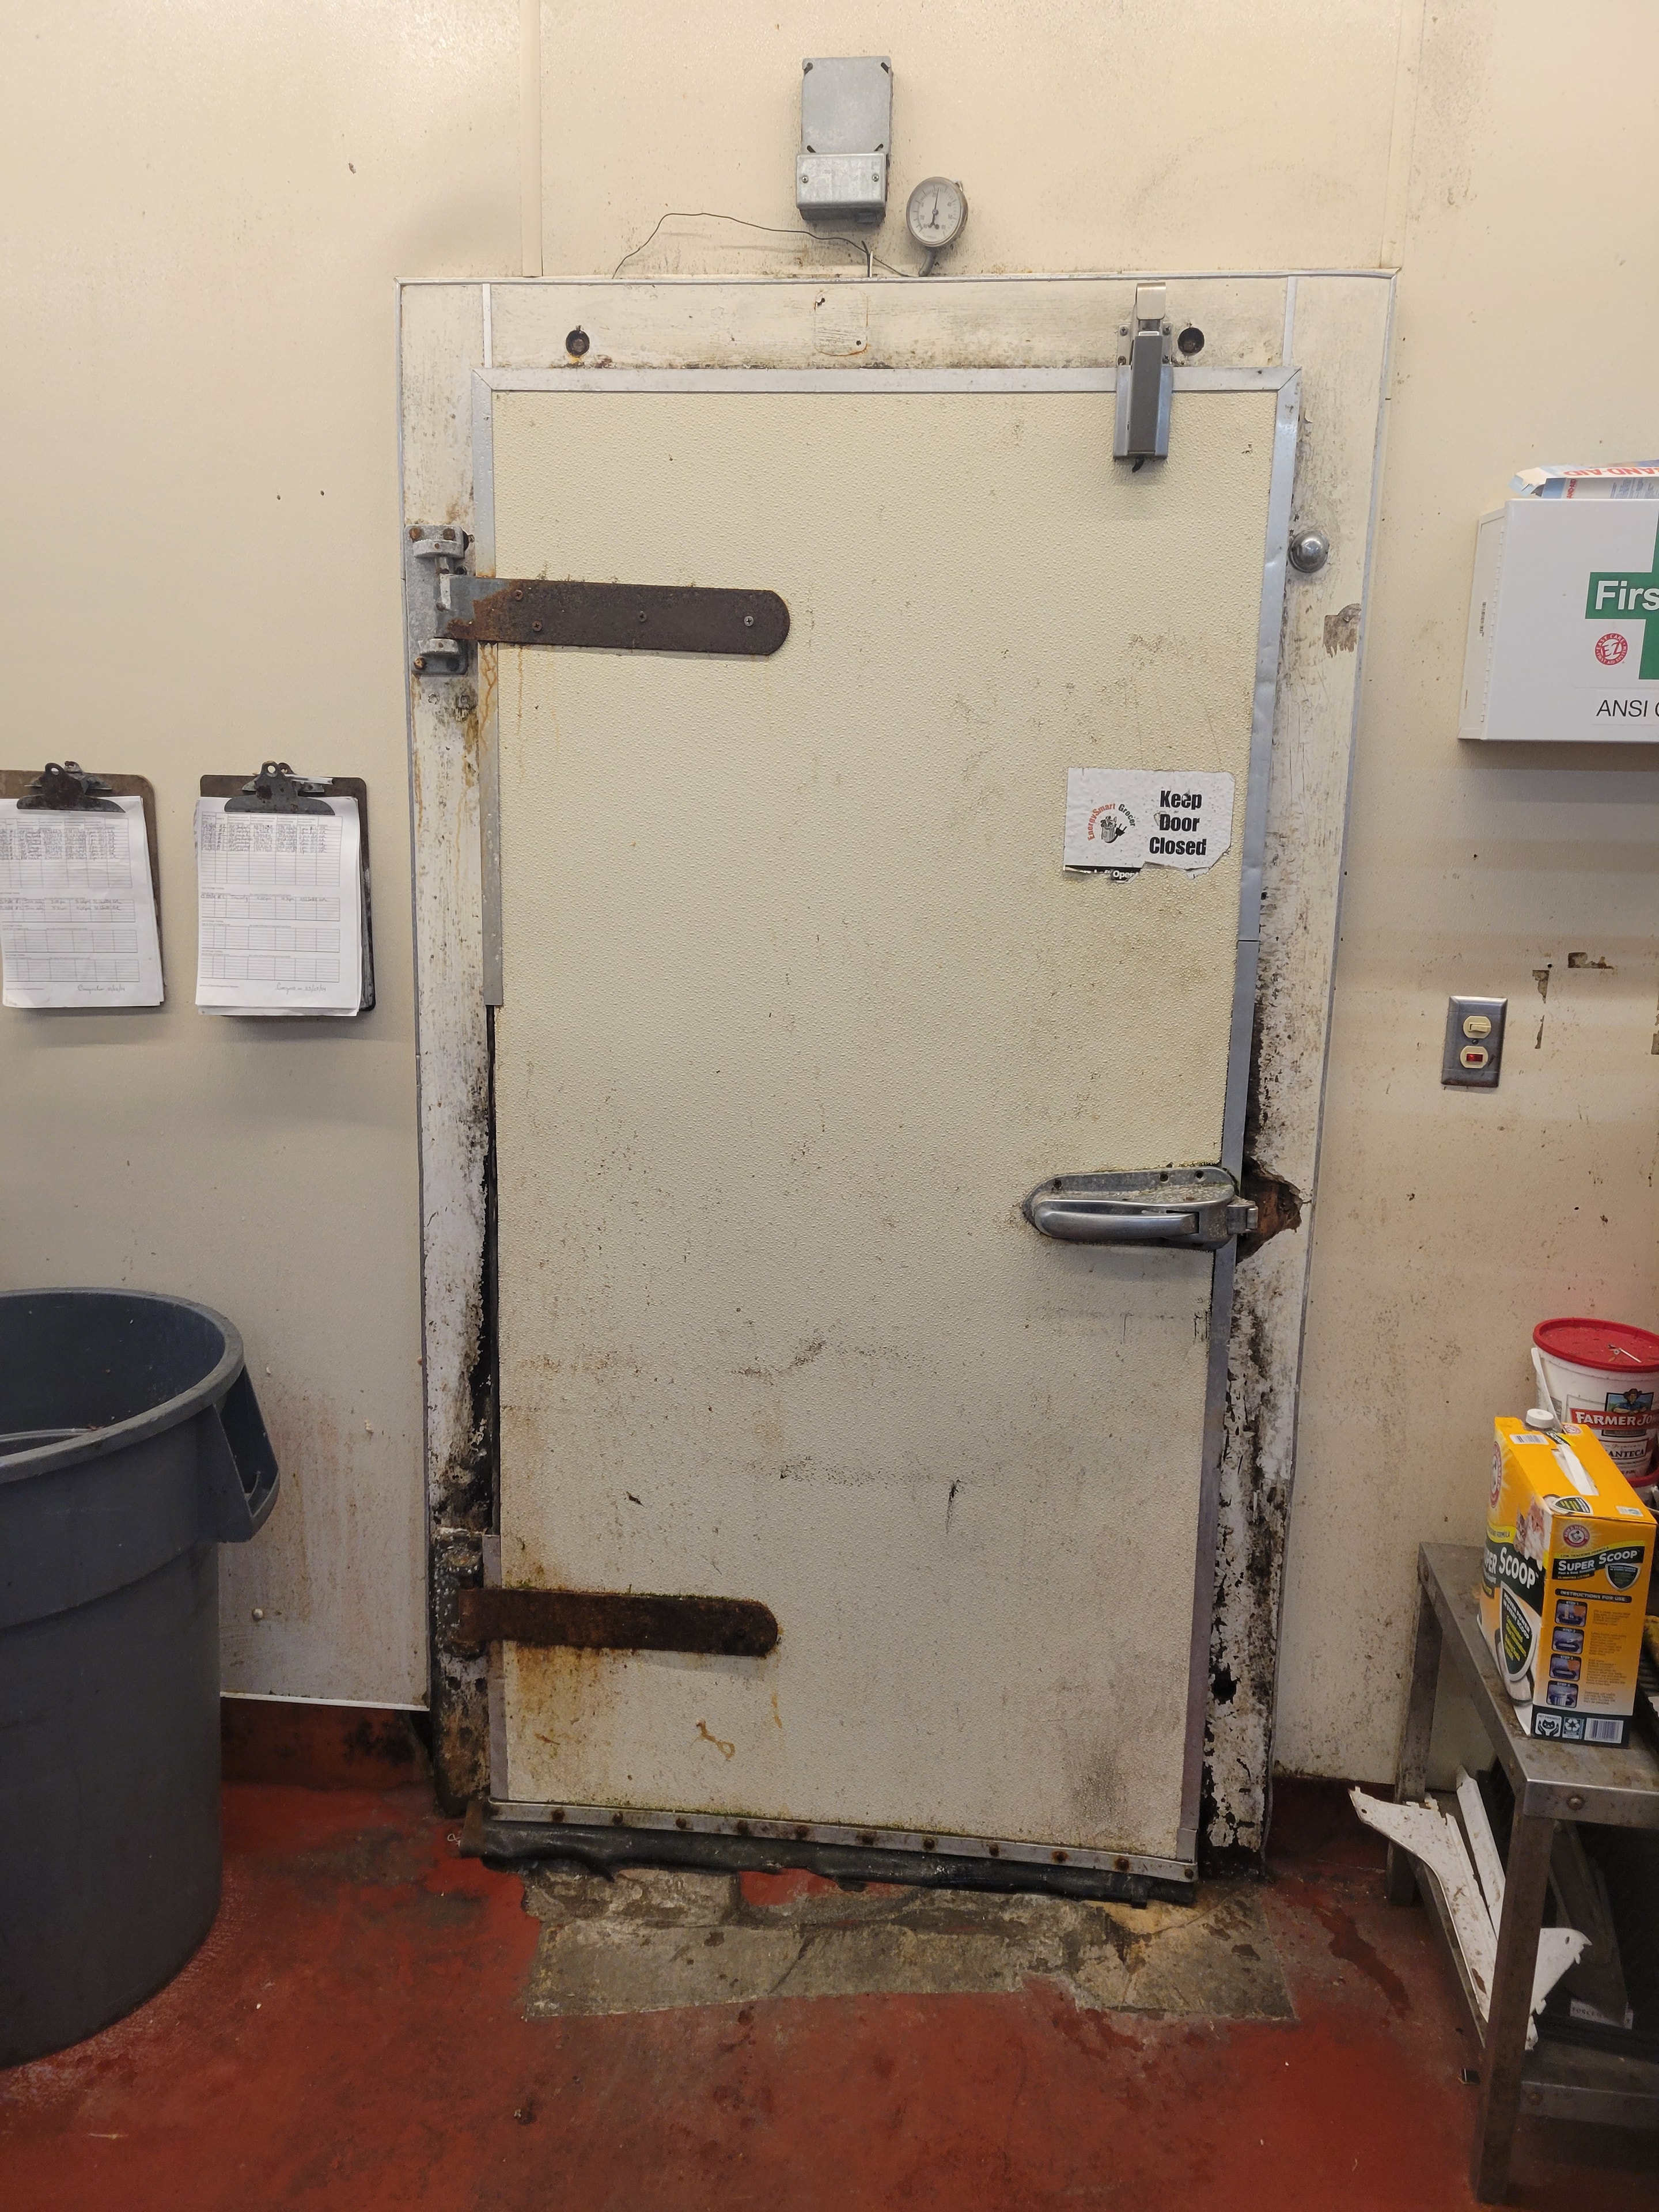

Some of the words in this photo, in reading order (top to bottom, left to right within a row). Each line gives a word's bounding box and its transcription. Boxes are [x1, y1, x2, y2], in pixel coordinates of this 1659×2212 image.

[1563, 467, 1659, 476] AND-AID
[1566, 479, 1577, 499] AND-AID
[1596, 636, 1608, 650] EASY
[1610, 634, 1624, 643] CARE
[1601, 641, 1622, 657] EZ
[1596, 699, 1648, 717] ANSI
[1160, 790, 1202, 810] Keep
[1118, 804, 1136, 827] Grocer
[1159, 813, 1200, 832] Door
[1149, 836, 1207, 856] Closed
[1575, 1411, 1637, 1426] FARMER
[1637, 1414, 1657, 1426] JOH
[1607, 1448, 1644, 1457] ANTECA
[1498, 1547, 1536, 1589] SCOOP
[1558, 1560, 1595, 1571] SUPER
[1599, 1550, 1638, 1565] SCOOP
[1560, 1590, 1601, 1599] INSTRUCTIONS
